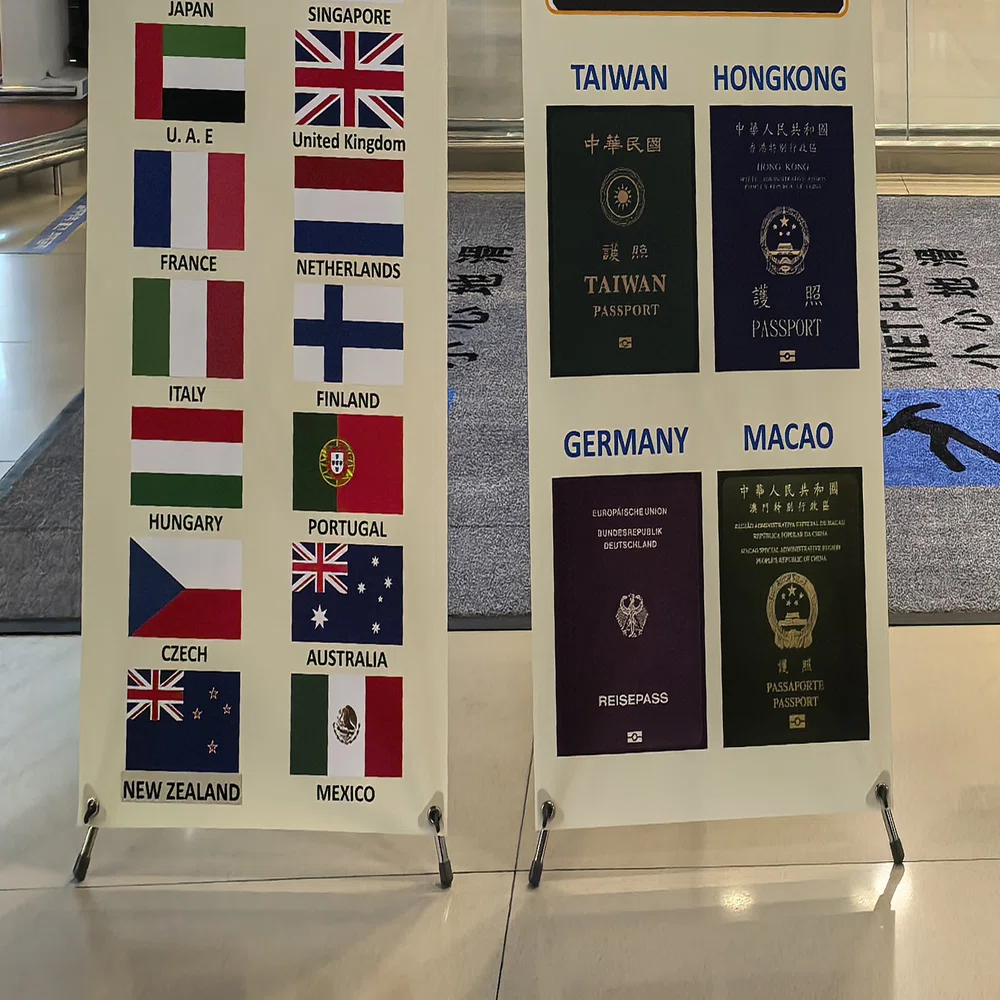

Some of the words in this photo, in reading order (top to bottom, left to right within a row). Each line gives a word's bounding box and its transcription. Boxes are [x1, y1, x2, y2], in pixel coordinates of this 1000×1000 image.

[168, 0, 214, 18] JAPAN
[308, 6, 391, 25] SINGAPORE
[570, 64, 668, 91] TAIWAN
[713, 64, 847, 92] HONGKONG
[292, 131, 340, 149] United
[344, 133, 406, 154] Kingdom
[584, 133, 662, 155] 中華民國
[756, 162, 781, 172] HONG
[785, 162, 810, 172] KONG
[160, 254, 217, 272] FRANCE
[296, 259, 401, 279] NETHERLANDS
[584, 273, 667, 295] TAIWAN
[592, 303, 660, 318] PASSPORT
[752, 318, 822, 338] PASSPORT
[880, 319, 938, 371] WET
[169, 385, 206, 403] ITALY
[316, 390, 380, 409] FINLAND
[564, 426, 689, 458] GERMANY
[744, 421, 834, 451] MACAO
[644, 507, 668, 516] UNION
[149, 513, 223, 532] HUNGARY
[308, 519, 387, 537] PORTUGAL
[597, 527, 663, 537] BUNDESREPUBLIK
[603, 540, 657, 550] DEUTSCHLAND
[161, 645, 208, 663] CZECH
[306, 649, 388, 668] AUSTRALIA
[766, 680, 824, 693] PASSAPORTE
[598, 692, 669, 707] REISEPASS
[773, 696, 819, 708] PASSPORT
[123, 780, 162, 801] NEW
[166, 782, 241, 802] ZEALAND
[316, 784, 375, 803] MEXICO
